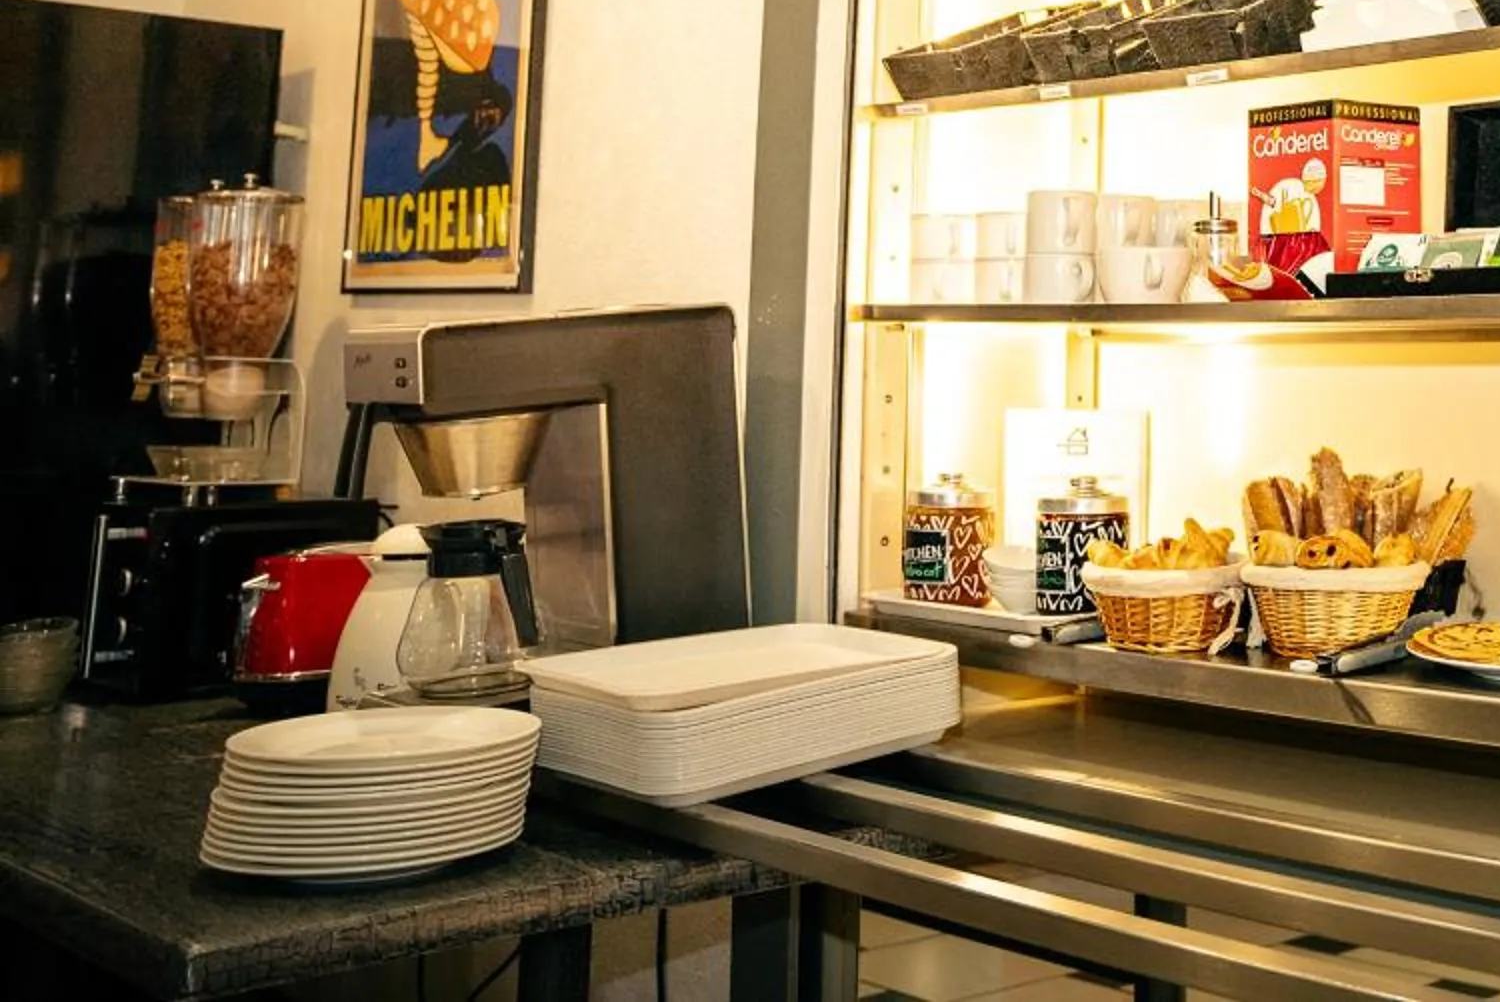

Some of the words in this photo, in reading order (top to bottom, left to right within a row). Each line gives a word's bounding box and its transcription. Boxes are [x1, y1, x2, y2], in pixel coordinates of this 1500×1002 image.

[1253, 102, 1328, 125] PROFESSIONAL
[1336, 101, 1420, 122] PROFESSIONAL
[1253, 128, 1330, 159] Canderel
[1341, 124, 1402, 148] Canderel
[360, 183, 510, 254] MICHELIN
